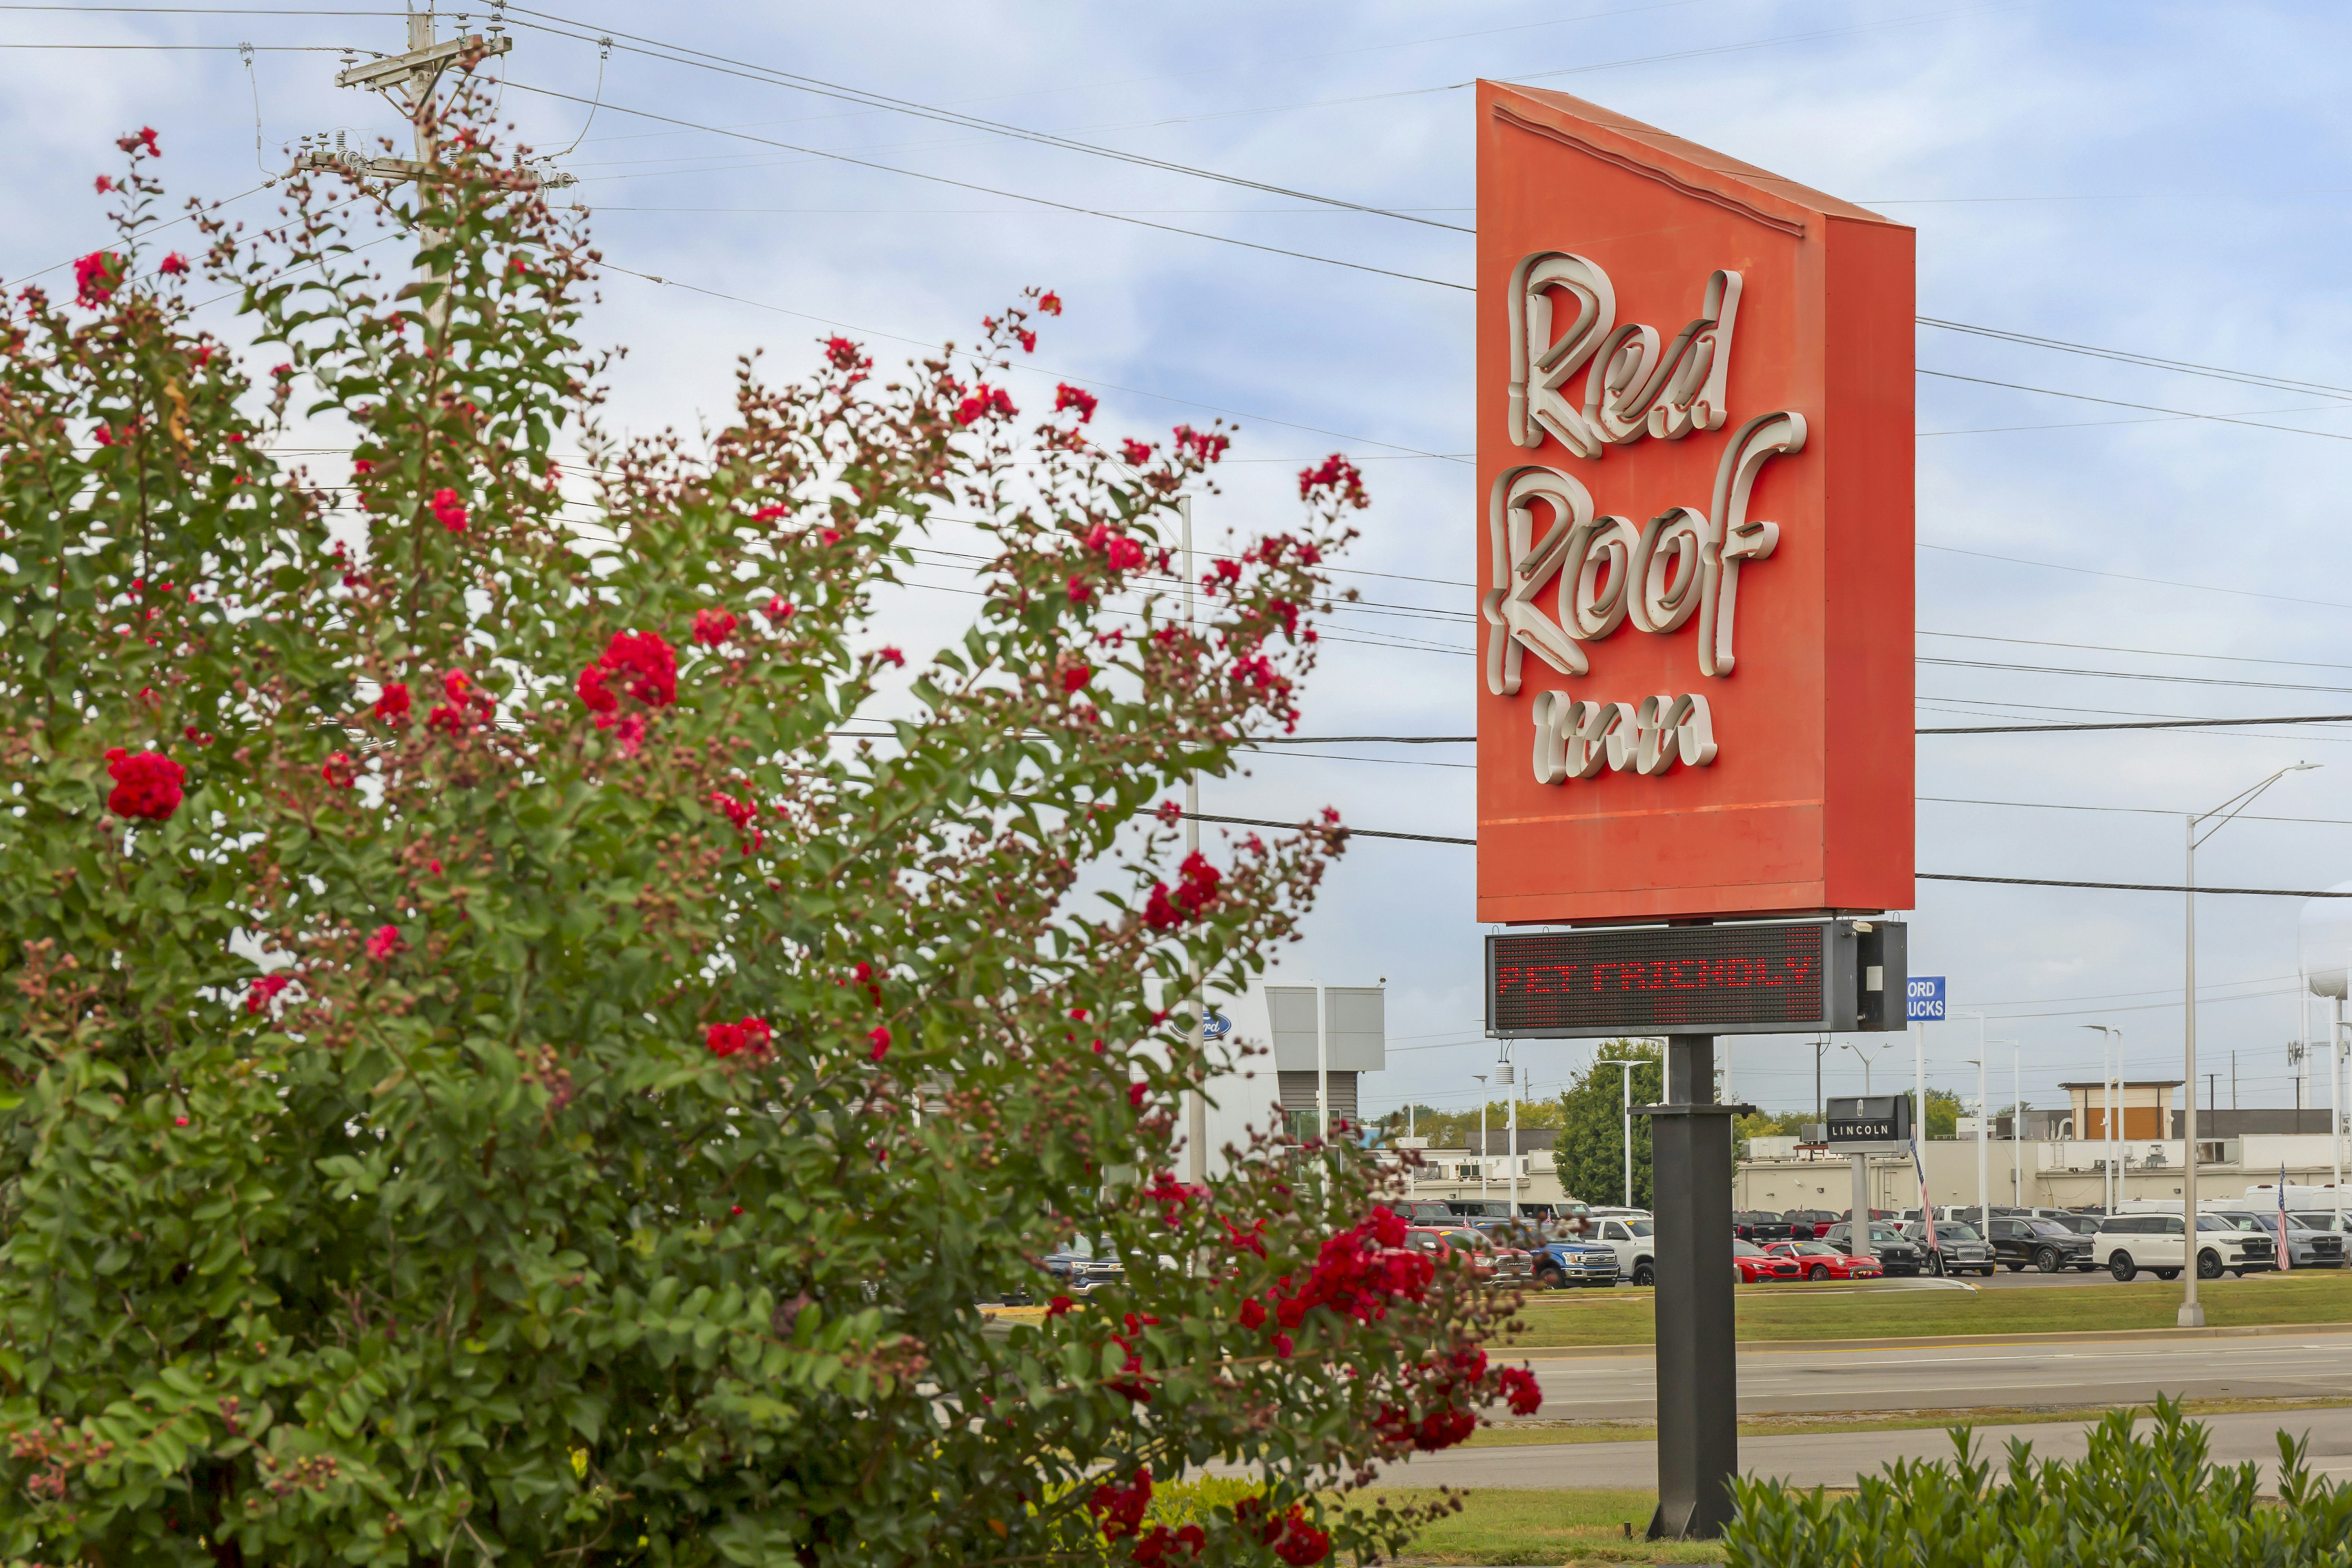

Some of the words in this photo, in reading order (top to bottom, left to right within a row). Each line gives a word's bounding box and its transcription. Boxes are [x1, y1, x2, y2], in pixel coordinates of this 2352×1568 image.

[1508, 251, 1742, 459] Red
[1483, 412, 1807, 695] Roof
[1499, 965, 1577, 993] PET
[1907, 981, 1935, 997] ORD
[1907, 1000, 1943, 1017] UCKS
[1833, 1125, 1888, 1136] LINCOLN
